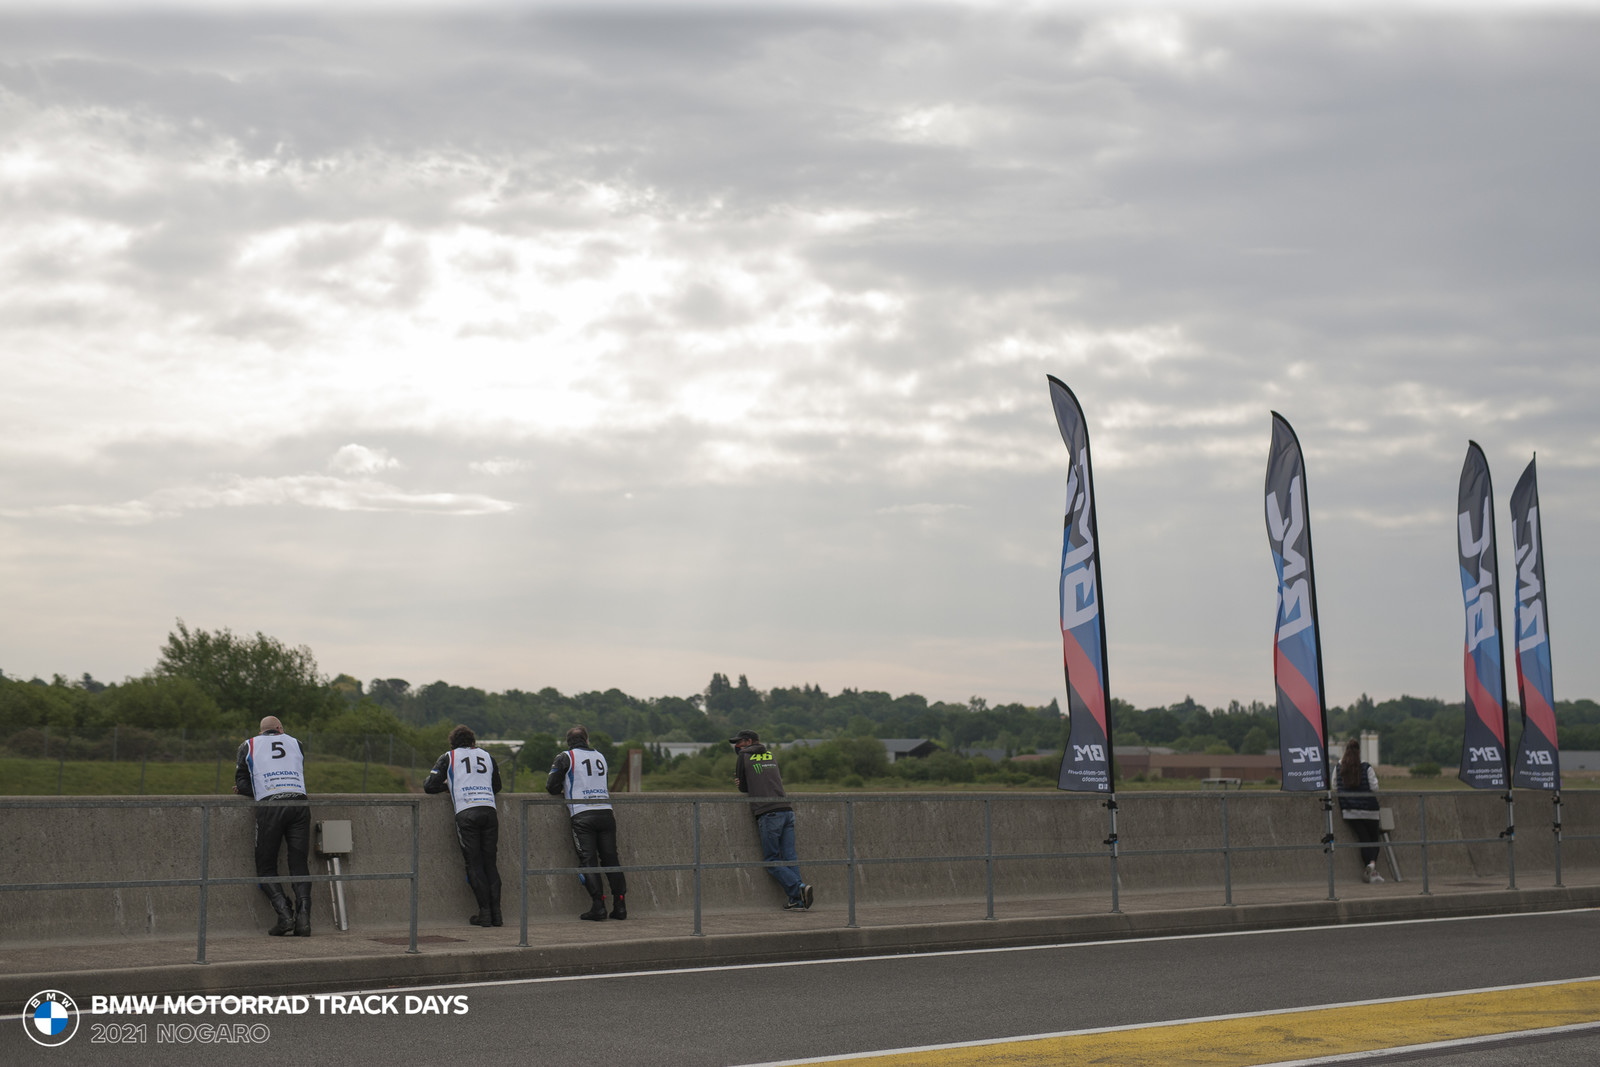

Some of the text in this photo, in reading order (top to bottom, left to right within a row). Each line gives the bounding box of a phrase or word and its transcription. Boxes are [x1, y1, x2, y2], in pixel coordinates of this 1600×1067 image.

[271, 741, 286, 759] 5
[749, 750, 773, 761] 46
[461, 756, 487, 774] 15
[581, 758, 605, 777] 19
